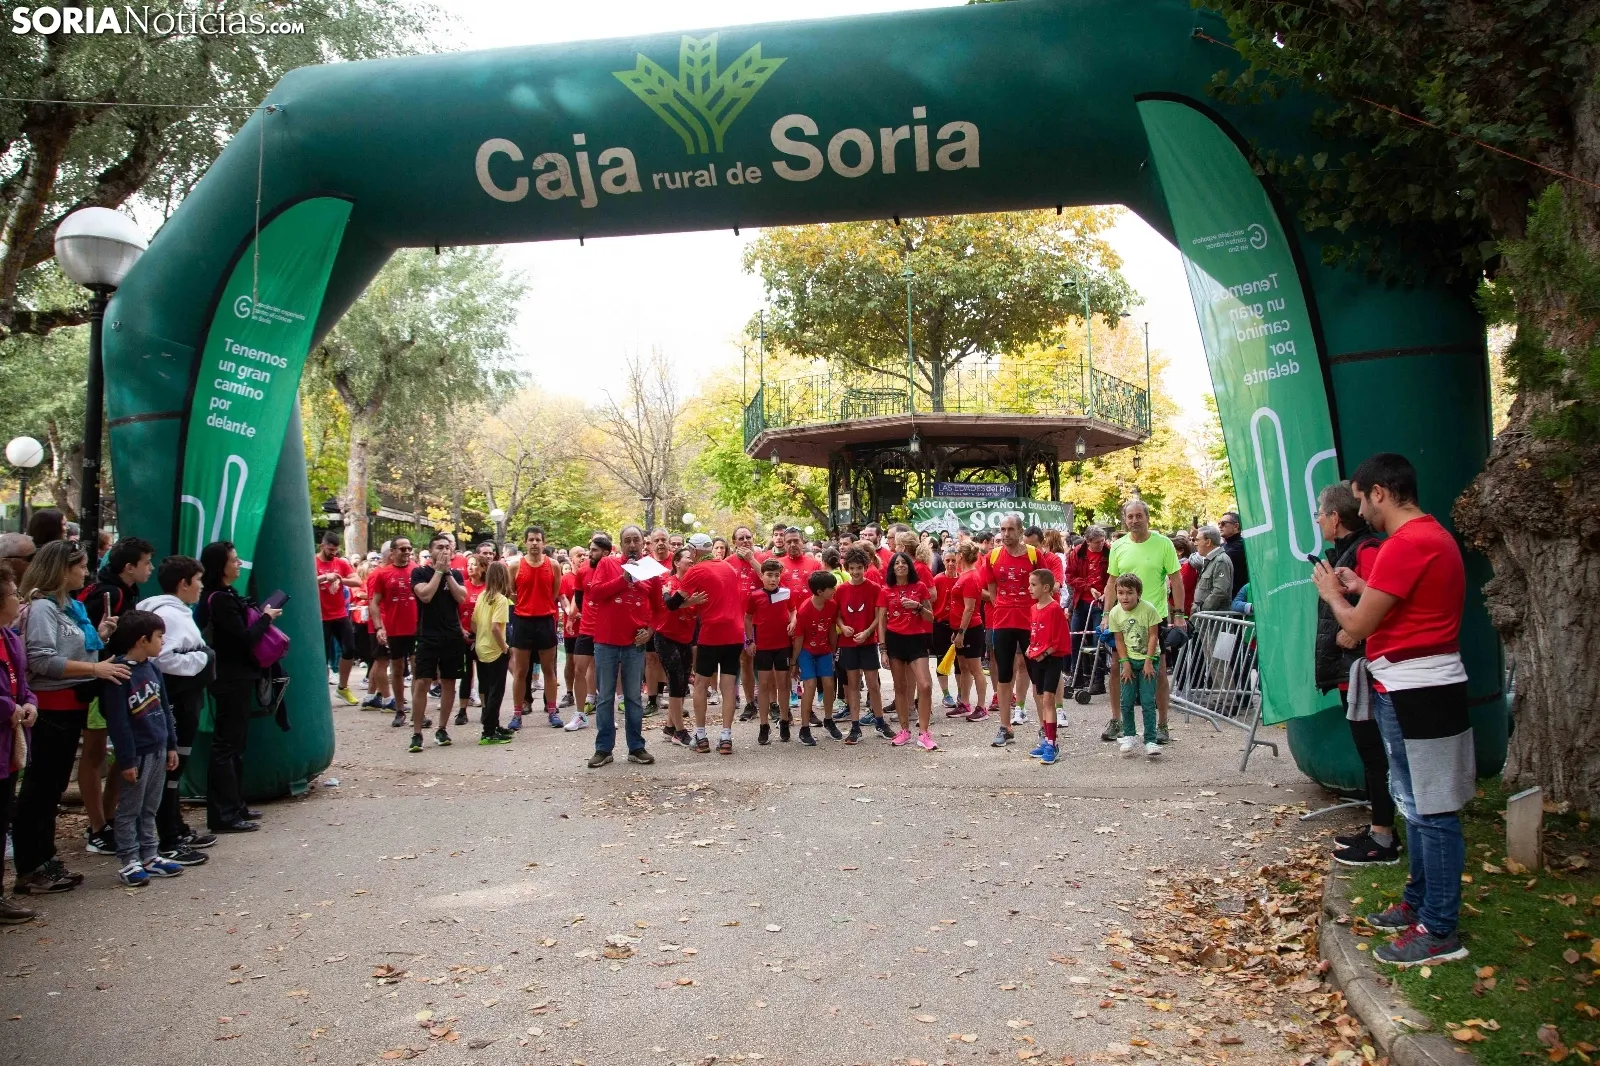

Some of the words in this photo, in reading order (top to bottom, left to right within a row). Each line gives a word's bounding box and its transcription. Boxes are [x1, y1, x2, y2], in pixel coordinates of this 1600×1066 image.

[475, 133, 643, 208] Caja
[652, 163, 718, 190] rural
[726, 162, 762, 186] de
[770, 105, 980, 182] Soria
[225, 338, 288, 369] Tenemos
[218, 360, 236, 373] un
[237, 365, 271, 383] gran
[214, 378, 264, 401] camino
[209, 396, 232, 411] por
[206, 412, 256, 438] delante
[985, 485, 998, 493] del
[912, 500, 974, 510] ASOCIACIÓN
[975, 498, 1027, 509] ESPAÑOLA
